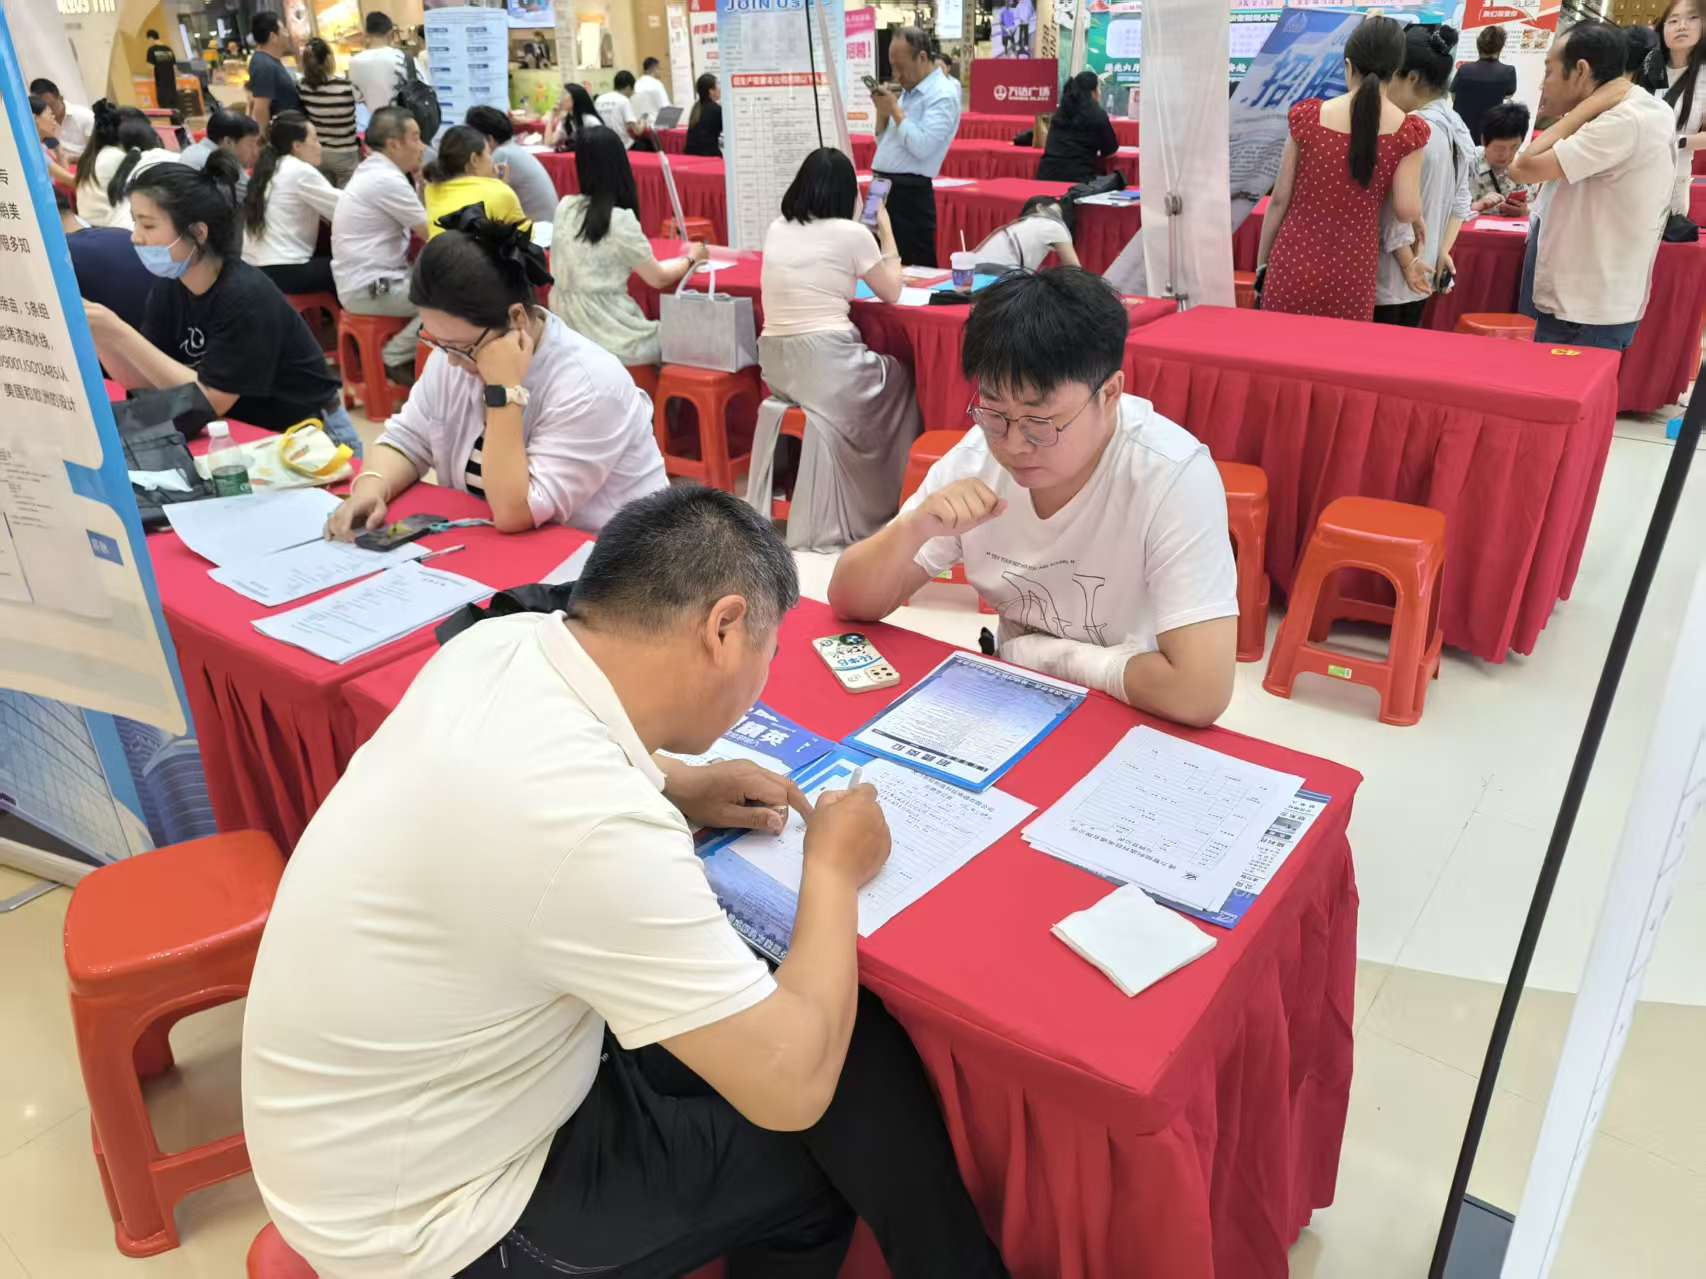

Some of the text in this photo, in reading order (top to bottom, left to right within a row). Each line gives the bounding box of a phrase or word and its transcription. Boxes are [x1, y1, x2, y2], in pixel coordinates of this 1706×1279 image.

[727, 0, 771, 12] JOIN
[1008, 86, 1051, 97] 万达广场
